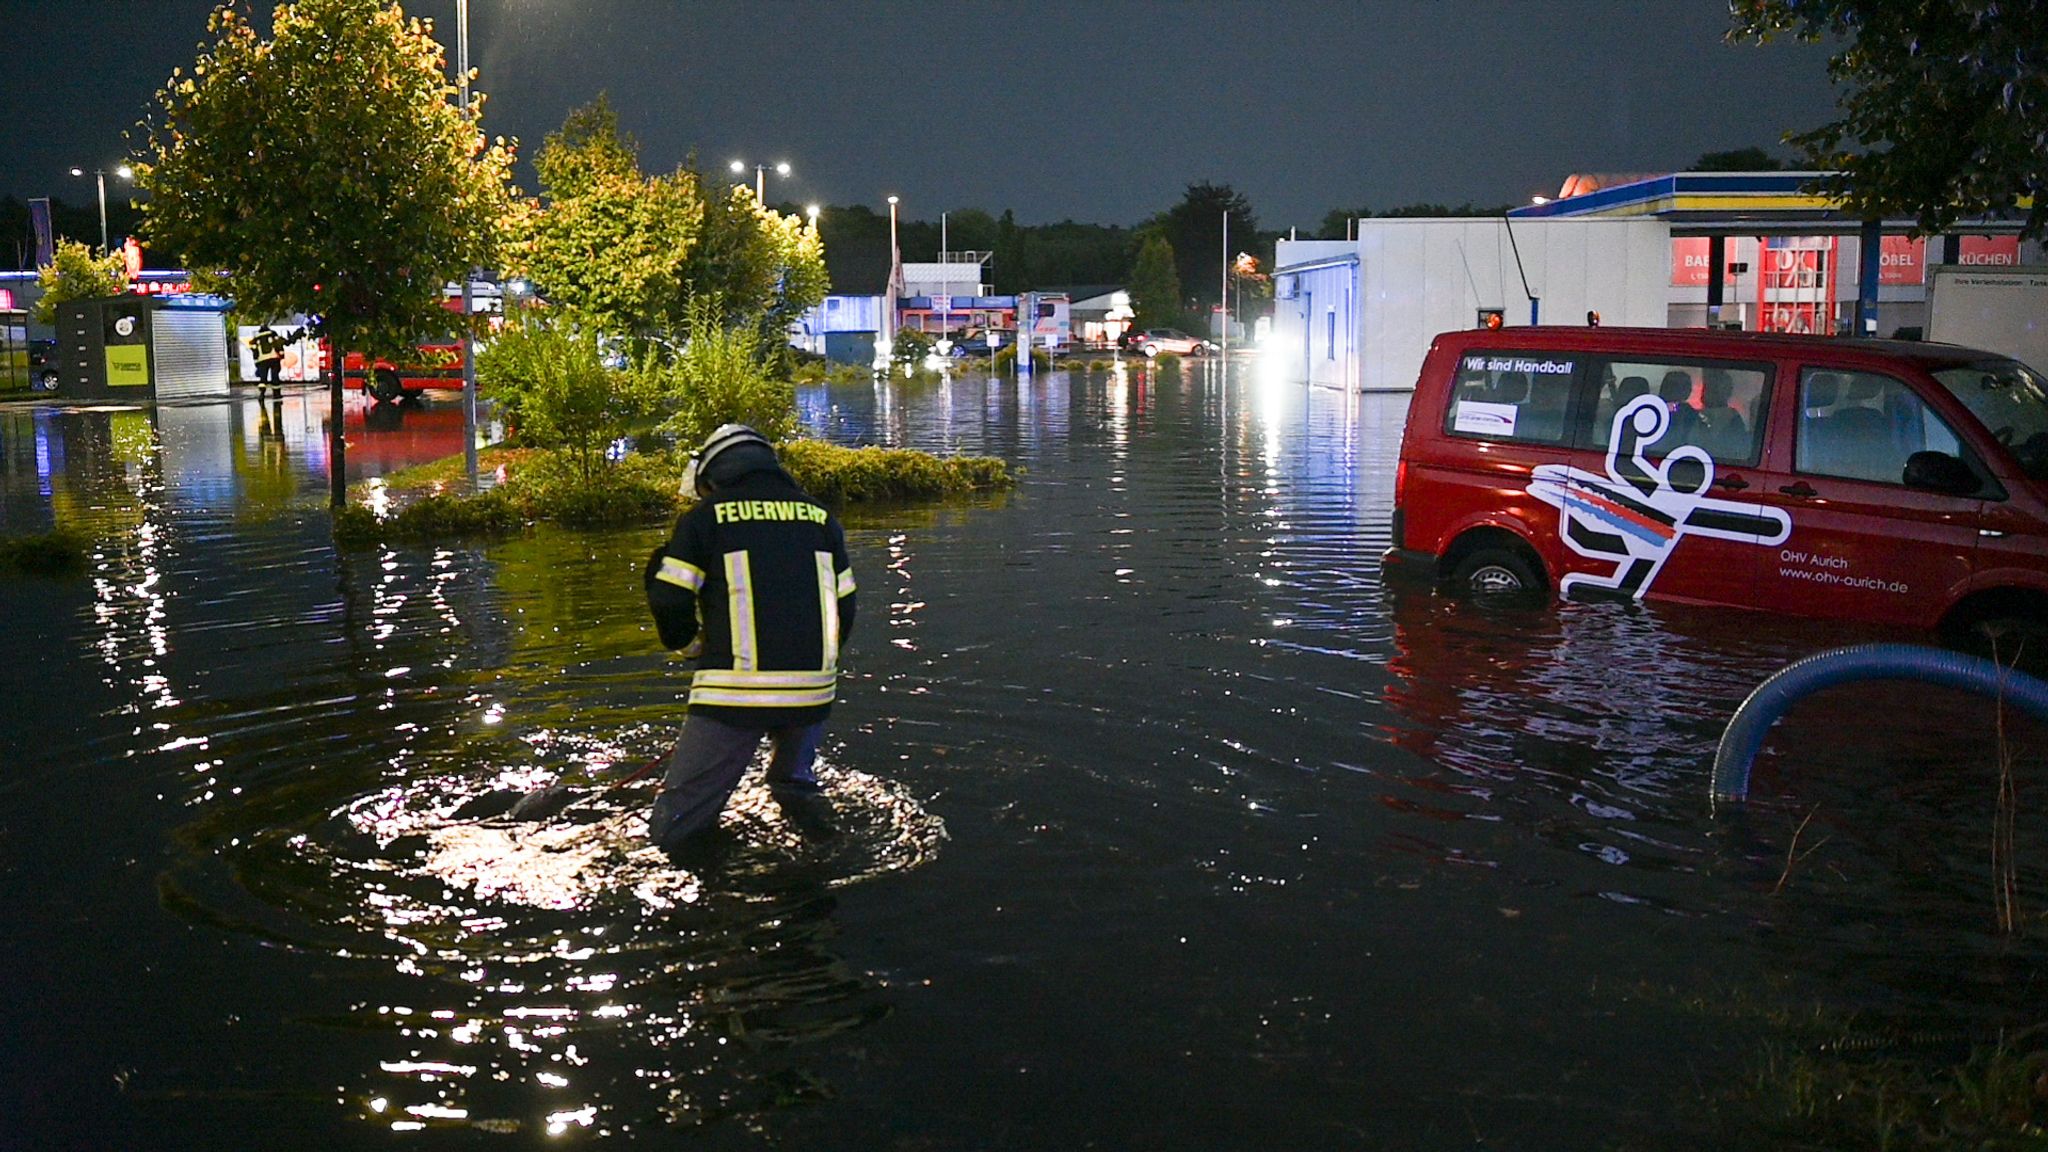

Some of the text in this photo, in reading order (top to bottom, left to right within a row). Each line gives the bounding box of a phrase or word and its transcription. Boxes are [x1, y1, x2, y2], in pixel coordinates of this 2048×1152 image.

[1880, 252, 1915, 266] ÖBEL
[1958, 253, 2012, 266] KÜCHEN
[1466, 358, 1573, 374] Wir sind Handball
[714, 500, 828, 526] FEUERWEHR
[1780, 549, 1848, 569] OHV Aurich
[1779, 567, 1909, 593] www.ohv-aurich.de
